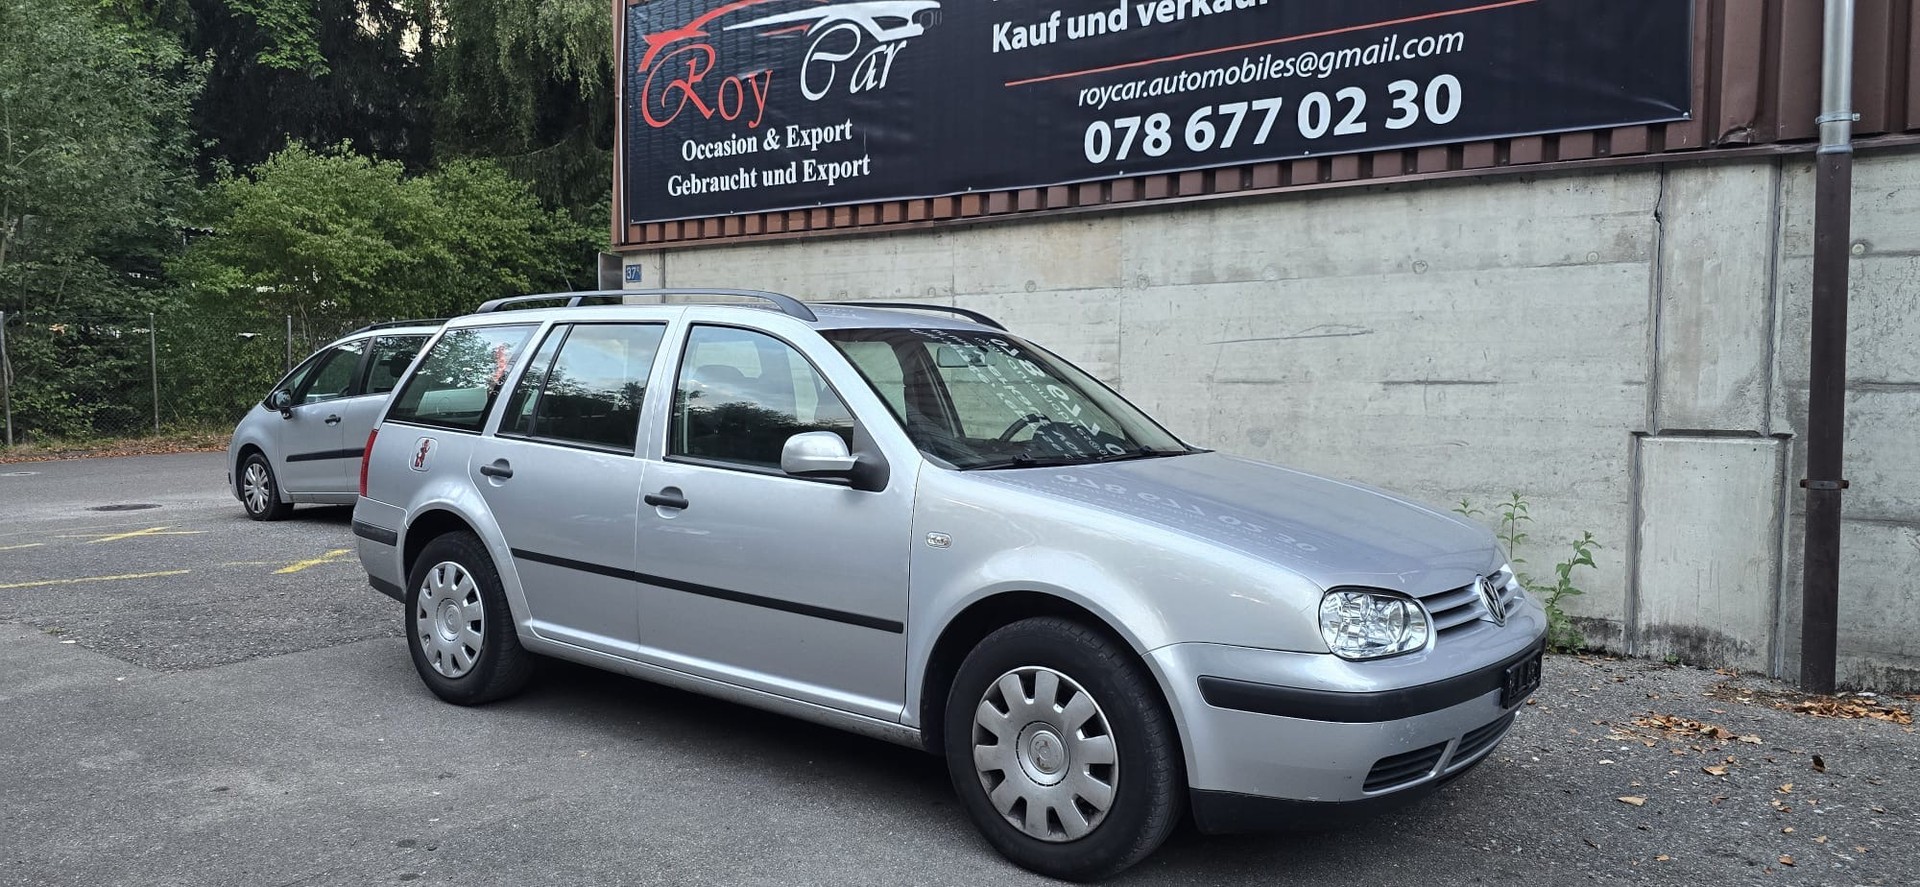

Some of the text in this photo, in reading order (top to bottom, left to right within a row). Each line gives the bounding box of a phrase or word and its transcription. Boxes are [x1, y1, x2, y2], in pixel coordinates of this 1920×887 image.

[992, 0, 1268, 53] Kauf und verka
[641, 23, 907, 128] Roy Car
[1078, 31, 1464, 110] roycar.automobiles@gmail.com
[682, 118, 853, 161] Occasion & Export
[1084, 73, 1462, 163] 078 677 02 30
[667, 153, 871, 197] Gebraucht und Export
